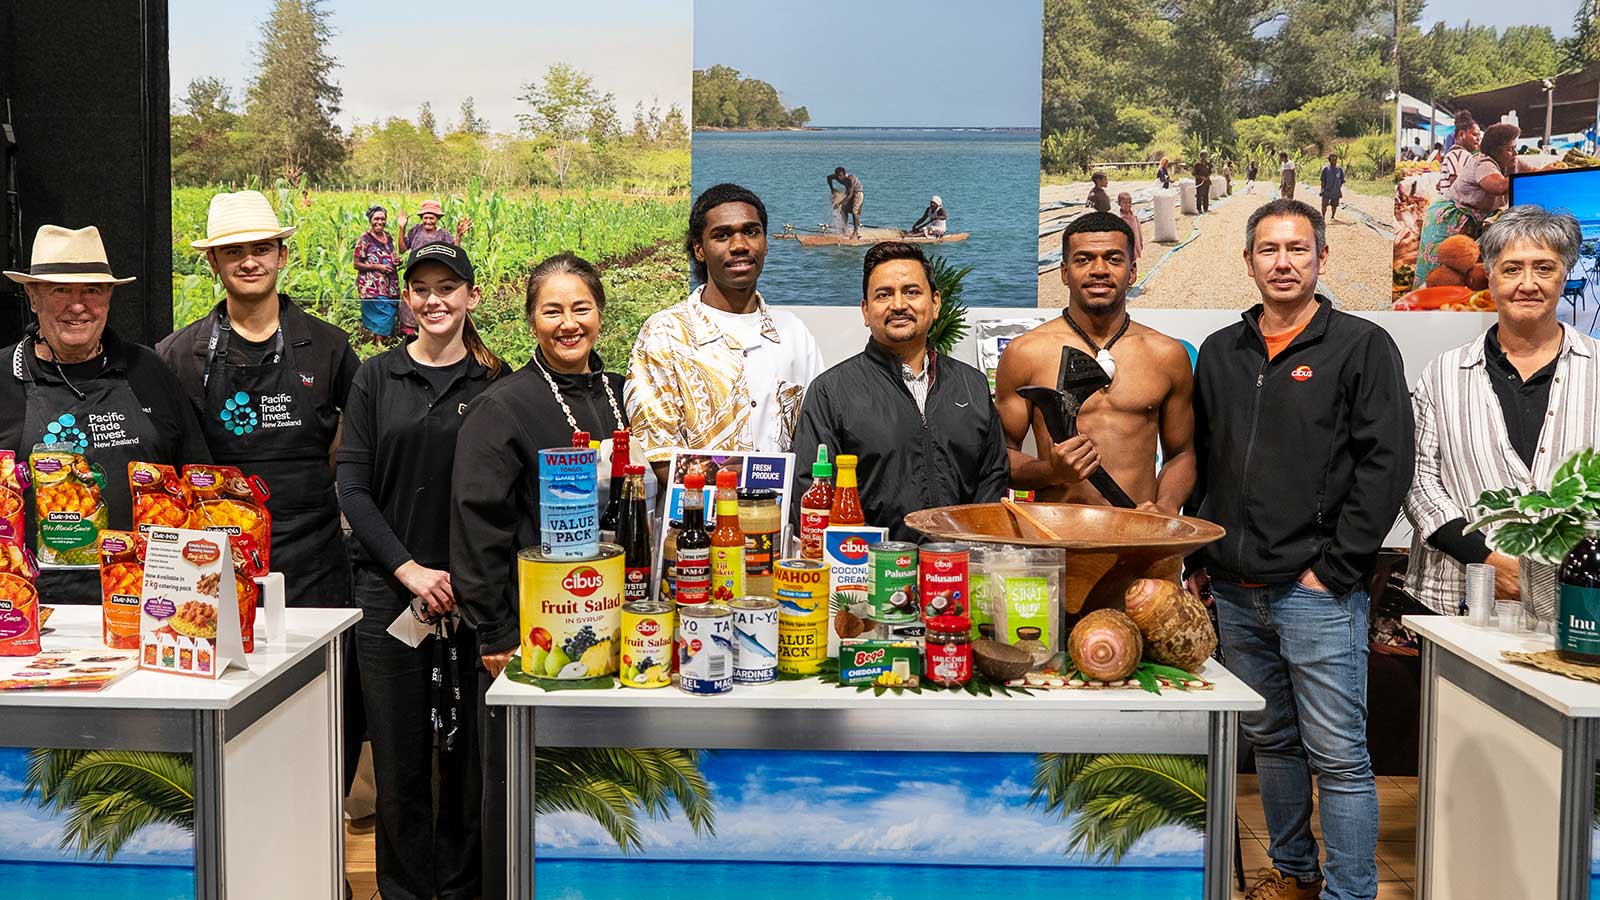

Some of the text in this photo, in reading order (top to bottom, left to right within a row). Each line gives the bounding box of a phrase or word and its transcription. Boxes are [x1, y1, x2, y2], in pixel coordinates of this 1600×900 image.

[261, 393, 292, 404] Pacific
[260, 404, 286, 413] Trade
[89, 412, 125, 423] Pacific
[262, 412, 290, 421] Invest
[88, 422, 120, 432] Trade
[93, 430, 126, 441] Invest
[111, 438, 139, 447] Zealand
[546, 453, 595, 466] WAHOO
[752, 472, 780, 480] PRODUCE
[550, 516, 594, 530] VALUE
[556, 529, 592, 543] PACK
[840, 540, 869, 553] cibus
[896, 556, 911, 565] cibus
[934, 559, 952, 567] cibus
[775, 568, 821, 583] WAHOO
[885, 569, 916, 578] Palusam
[926, 573, 962, 583] Palusami
[150, 581, 158, 589] kg
[563, 574, 602, 588] cibus
[541, 593, 621, 614] Fruit Salad
[576, 615, 604, 623] SYRUP
[1569, 615, 1595, 630] Inu
[637, 622, 659, 631] cibus
[682, 620, 697, 631] YO
[714, 621, 729, 632] TA
[624, 636, 672, 647] Fruit Salad
[779, 634, 814, 645] ALUE
[855, 648, 885, 666] Bega
[848, 668, 881, 677] CHEDDAR
